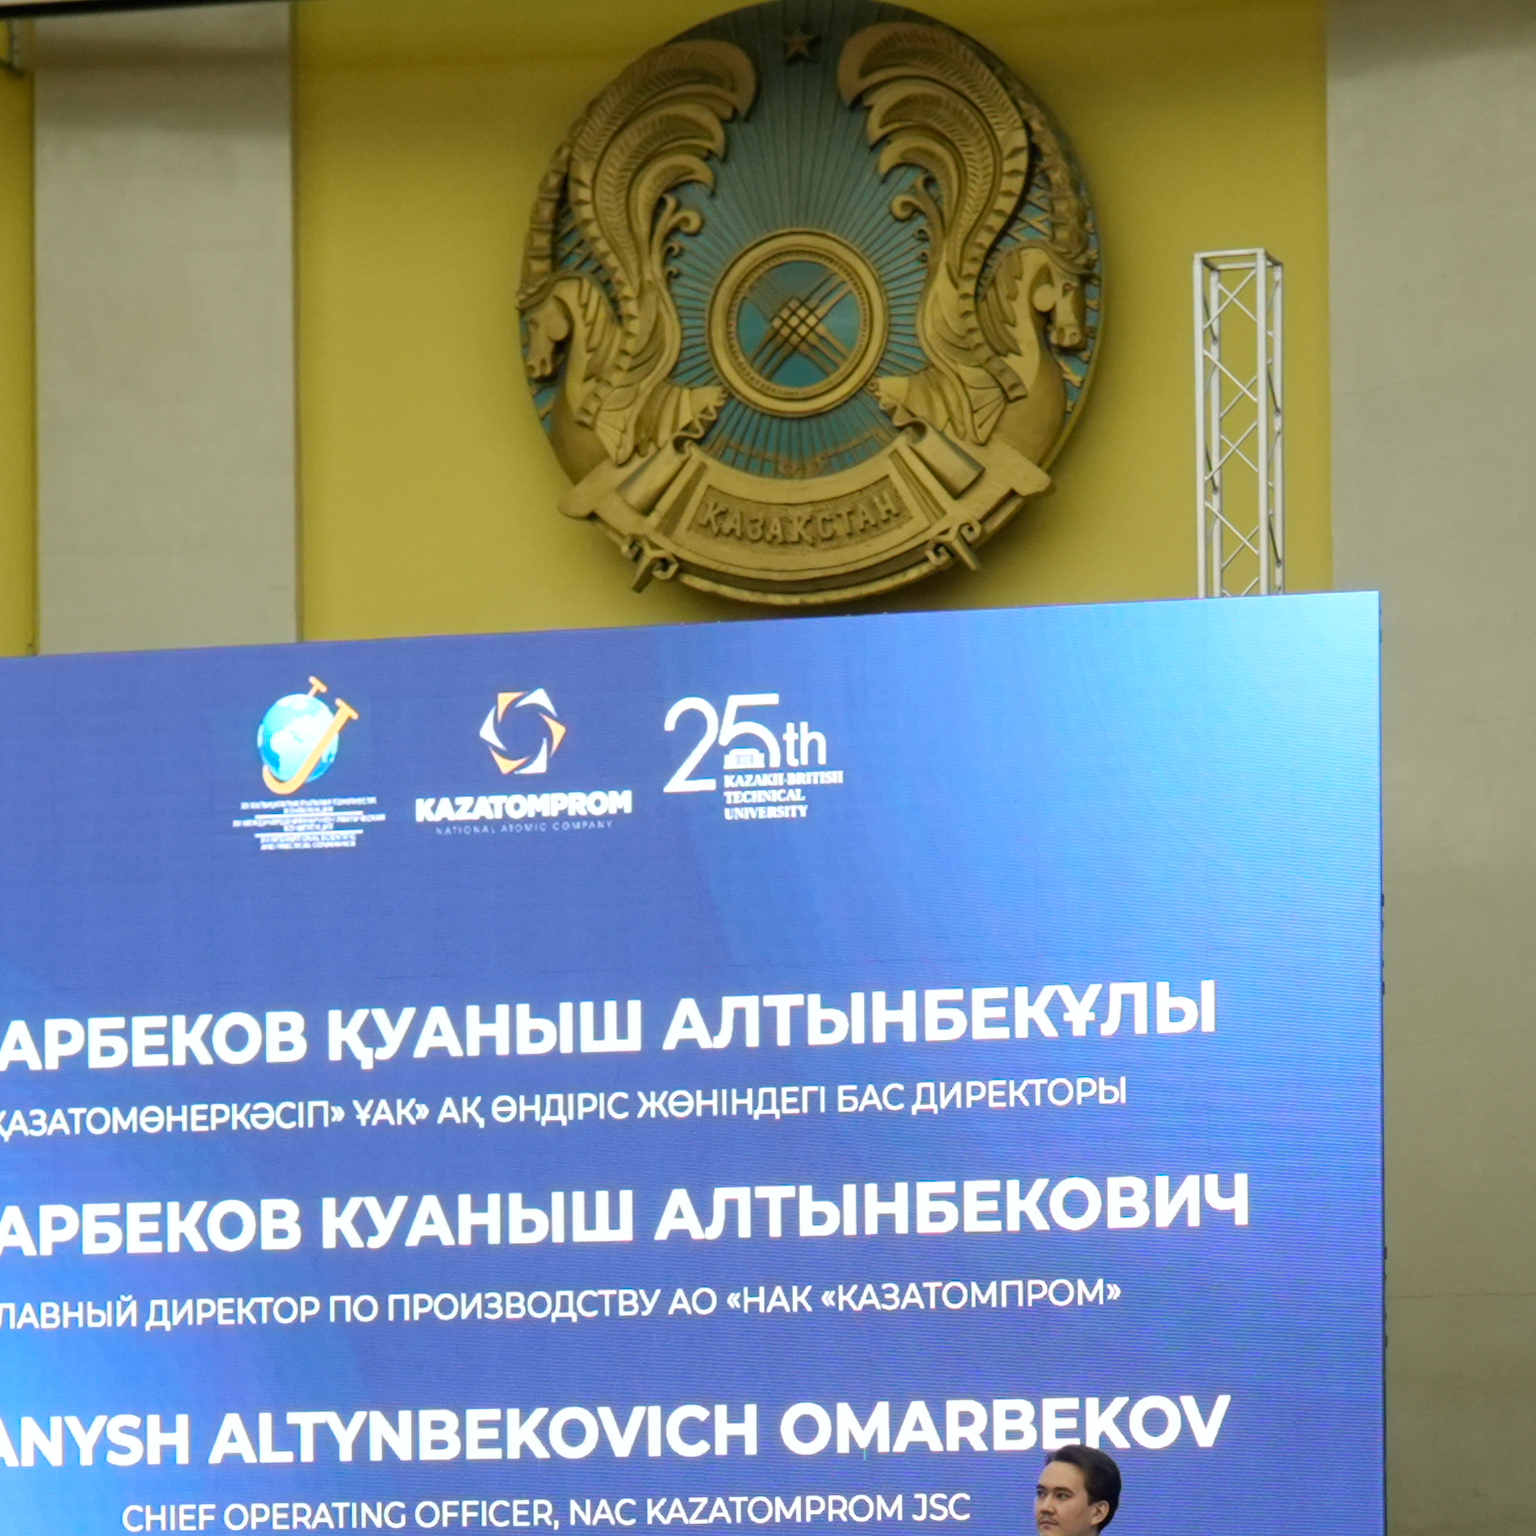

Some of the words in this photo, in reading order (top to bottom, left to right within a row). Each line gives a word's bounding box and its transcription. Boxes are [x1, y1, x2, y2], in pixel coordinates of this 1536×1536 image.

[724, 771, 843, 788] KAZAKH-BRITISH
[724, 789, 805, 804] TECHNICAL
[416, 791, 632, 822] KAZATOMPROM
[725, 805, 807, 820] UNIVERSITY
[435, 825, 495, 836] NATIONAL
[552, 820, 613, 831] COMPANY
[329, 1000, 641, 1070] ҚУАНЫШ
[663, 980, 1215, 1050] АЛТЫНБЕКҰЛЫ
[352, 1098, 429, 1126] ҰАК»
[438, 1097, 484, 1128] АҚ
[492, 1092, 628, 1126] ӨНДІРІС
[638, 1086, 825, 1120] ЖӨНІНДЕГІ
[838, 1084, 904, 1112] БАС
[912, 1077, 1126, 1115] ДИРЕКТОРЫ
[323, 1190, 633, 1249] КУАНЫШ
[655, 1174, 1248, 1240] АЛТЫНБЕКОВИЧ
[146, 1297, 320, 1331] ДИРЕКТОР
[330, 1296, 378, 1322] ПО
[389, 1289, 660, 1322] ПРОИЗВОДСТВУ
[668, 1288, 716, 1315] АО
[727, 1286, 812, 1313] «НАК
[822, 1279, 1121, 1311] «КАЗАТОМПРОМ»
[209, 1404, 757, 1464] ALTYNBEKOVICH
[780, 1395, 1230, 1455] OMARBEKOV
[123, 1504, 216, 1532] CHIEF
[225, 1502, 405, 1530] OPERATING
[415, 1500, 559, 1530] OFFICER,
[570, 1499, 636, 1525] NAC
[648, 1495, 902, 1524] KAZATOMPROM
[912, 1493, 970, 1521] JSC
